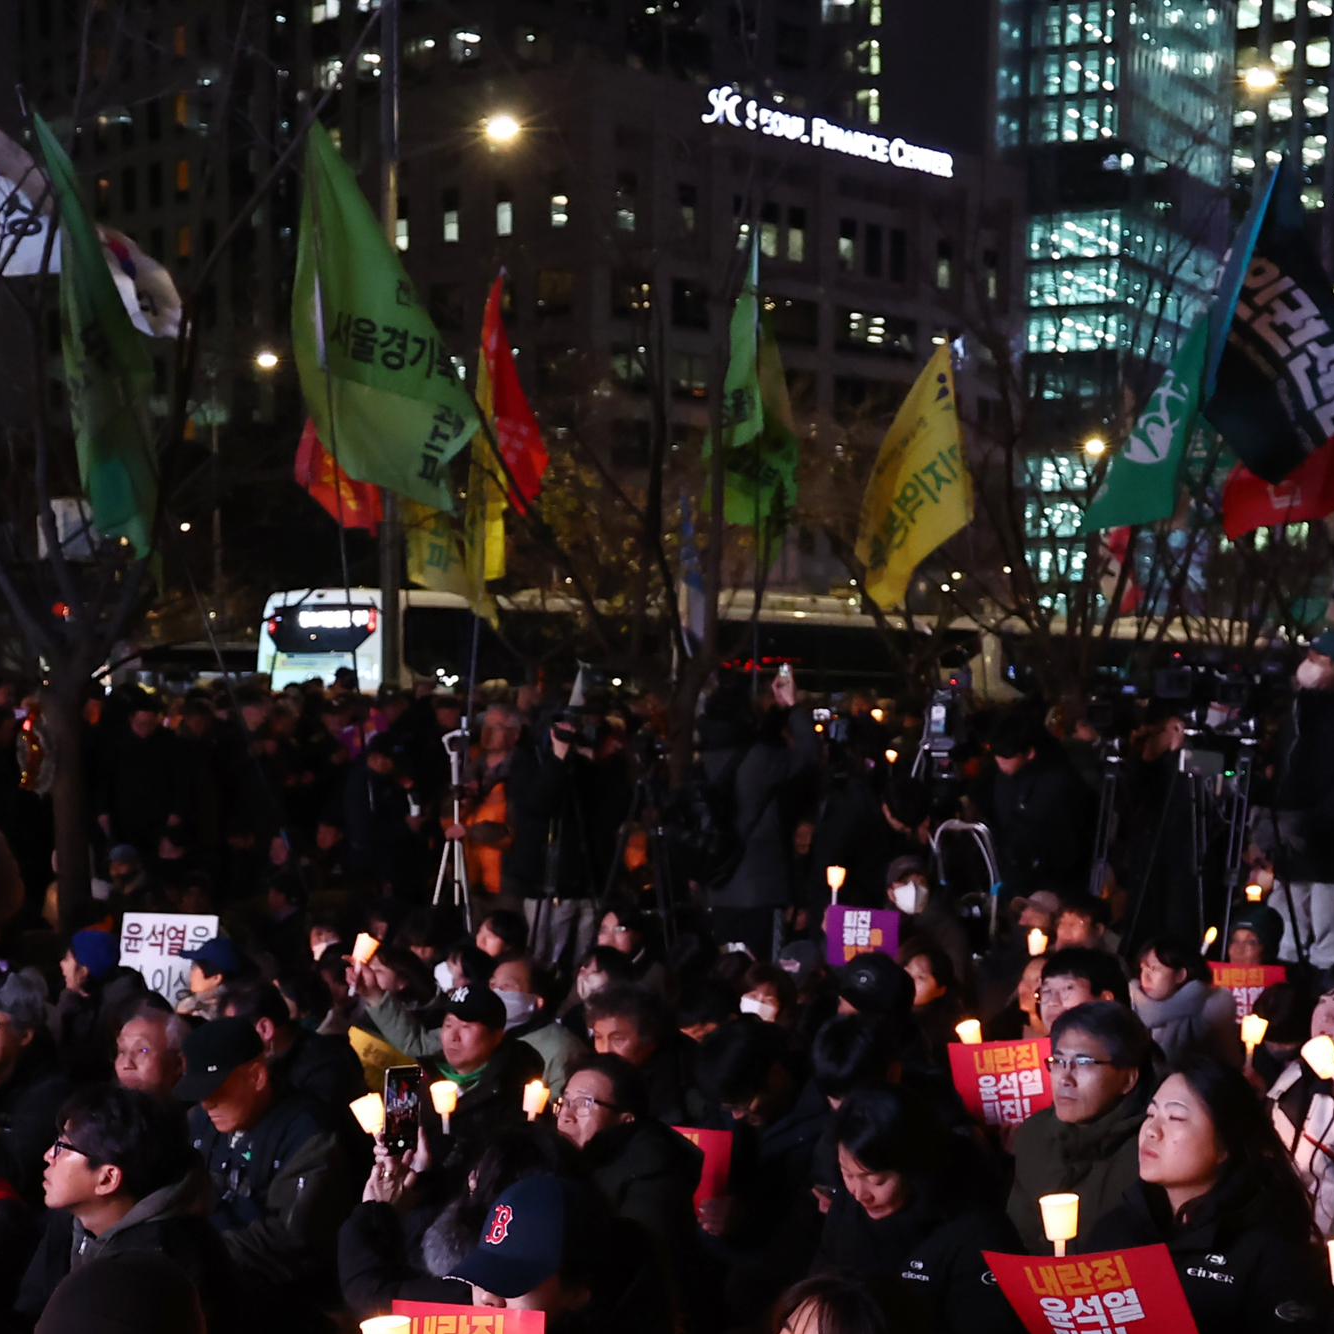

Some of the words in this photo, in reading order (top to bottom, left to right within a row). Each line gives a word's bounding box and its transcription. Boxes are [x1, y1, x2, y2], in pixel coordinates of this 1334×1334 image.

[812, 117, 889, 163] FINANCE
[889, 138, 954, 178] CENTER
[973, 1042, 1040, 1075] 내란죄
[978, 1068, 1045, 1101] 윤석열
[483, 1204, 514, 1246] B
[1024, 1255, 1132, 1296] 내란죄
[1039, 1287, 1145, 1329] 윤석열
